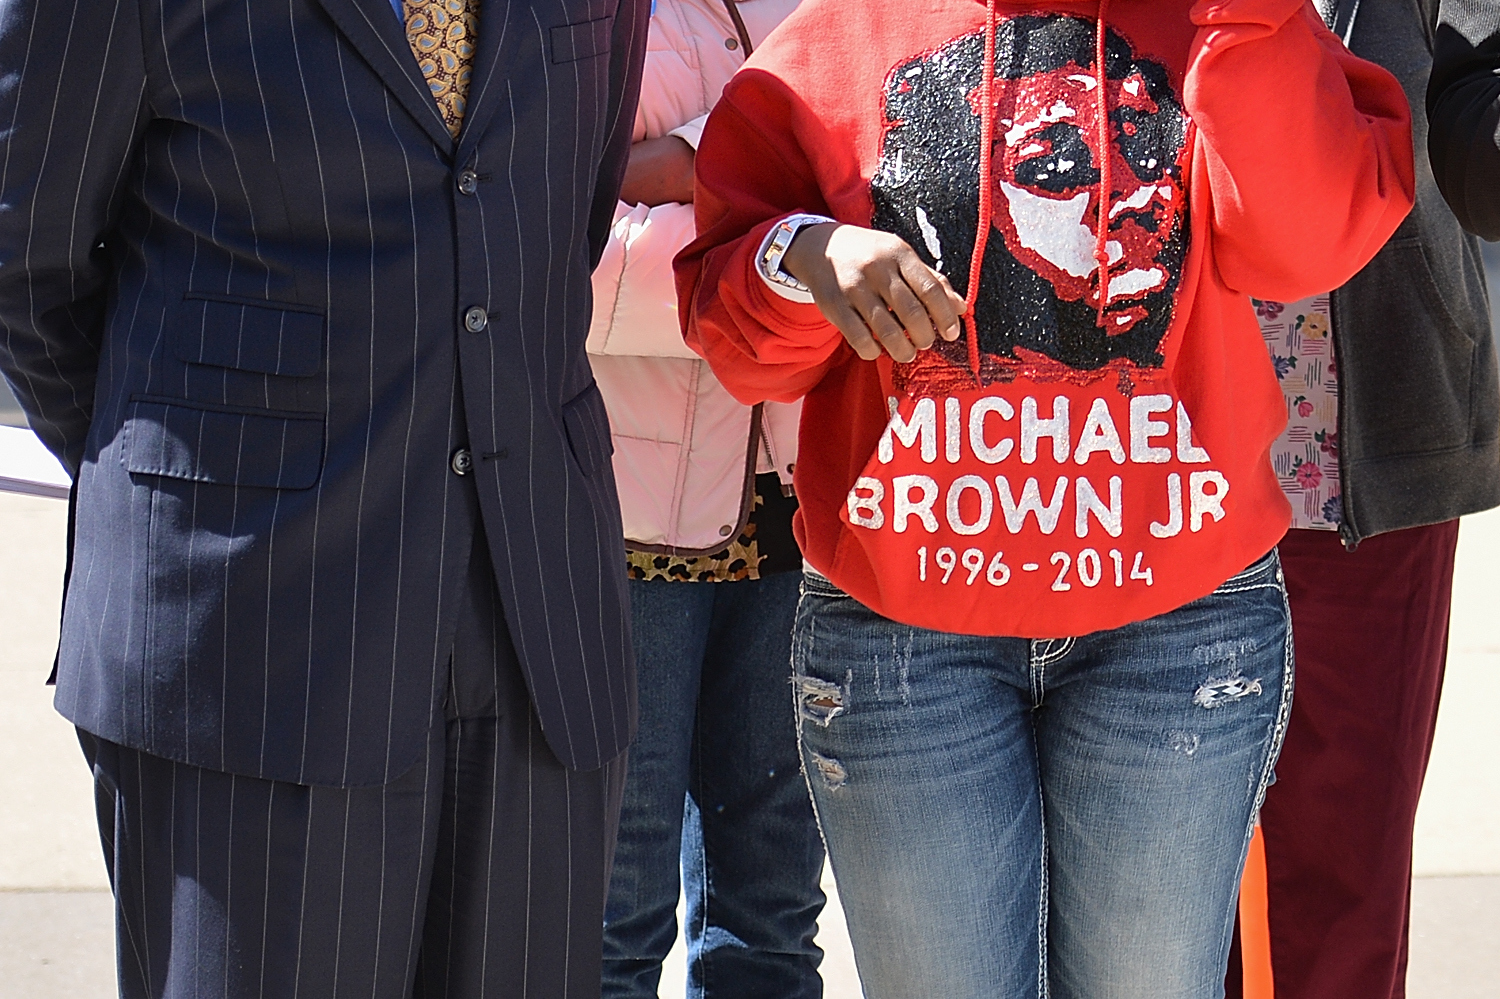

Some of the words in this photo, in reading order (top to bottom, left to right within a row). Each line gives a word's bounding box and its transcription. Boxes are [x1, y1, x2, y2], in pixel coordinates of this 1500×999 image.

[877, 393, 1212, 465] MICHAEL
[846, 473, 1123, 539] BROWN
[1149, 470, 1230, 539] JR
